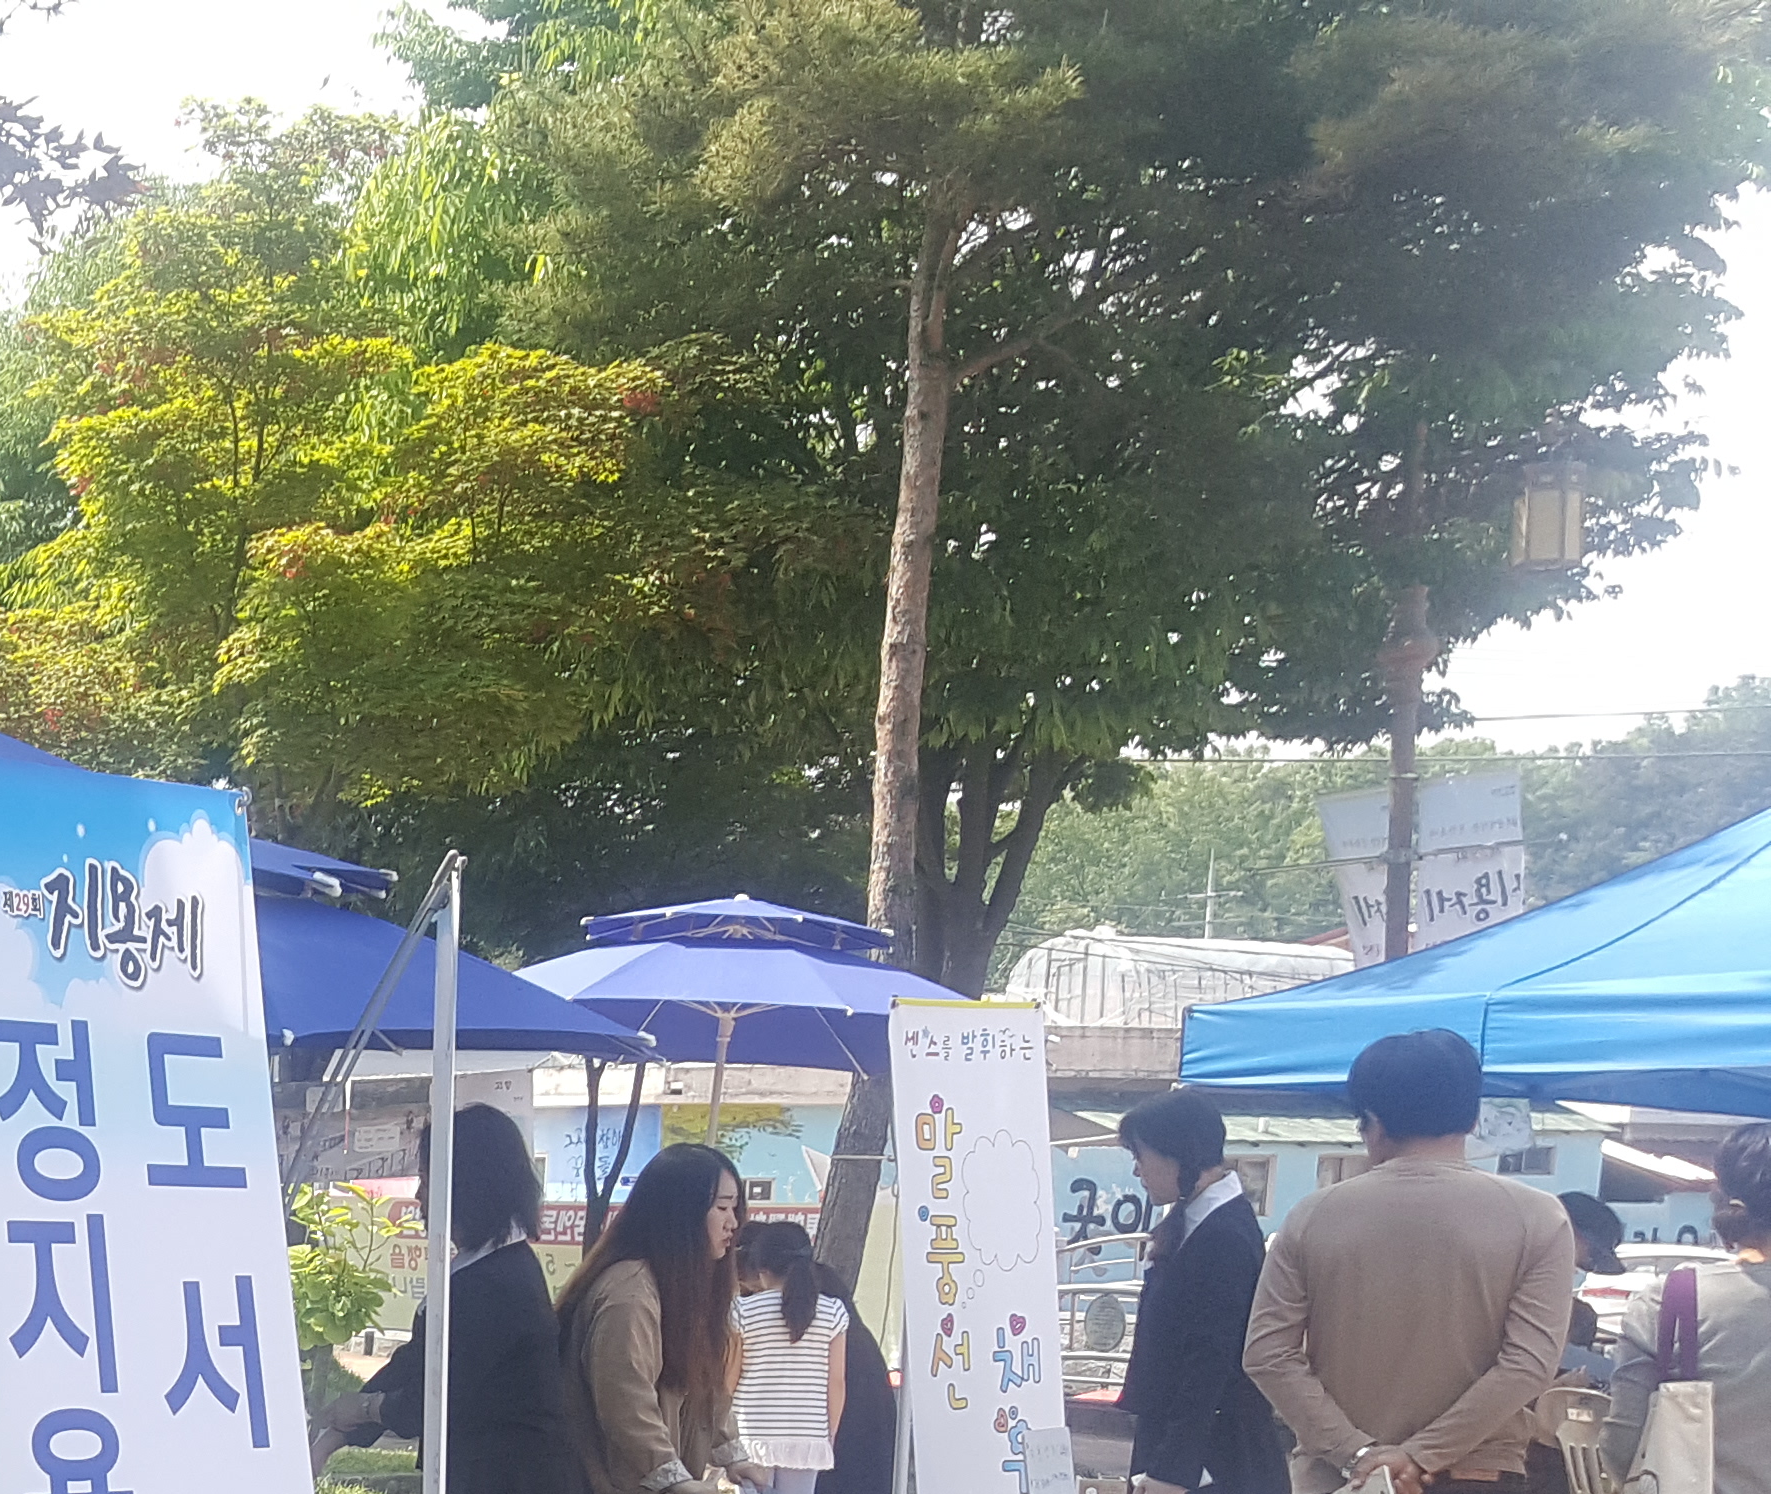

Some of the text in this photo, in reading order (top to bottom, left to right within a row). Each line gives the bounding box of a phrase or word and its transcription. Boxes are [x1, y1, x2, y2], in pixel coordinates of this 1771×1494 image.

[2, 861, 201, 983] 제29회 지용제
[904, 1027, 1034, 1062] 센스를 발휘하는
[915, 1103, 971, 1411] 말풍선
